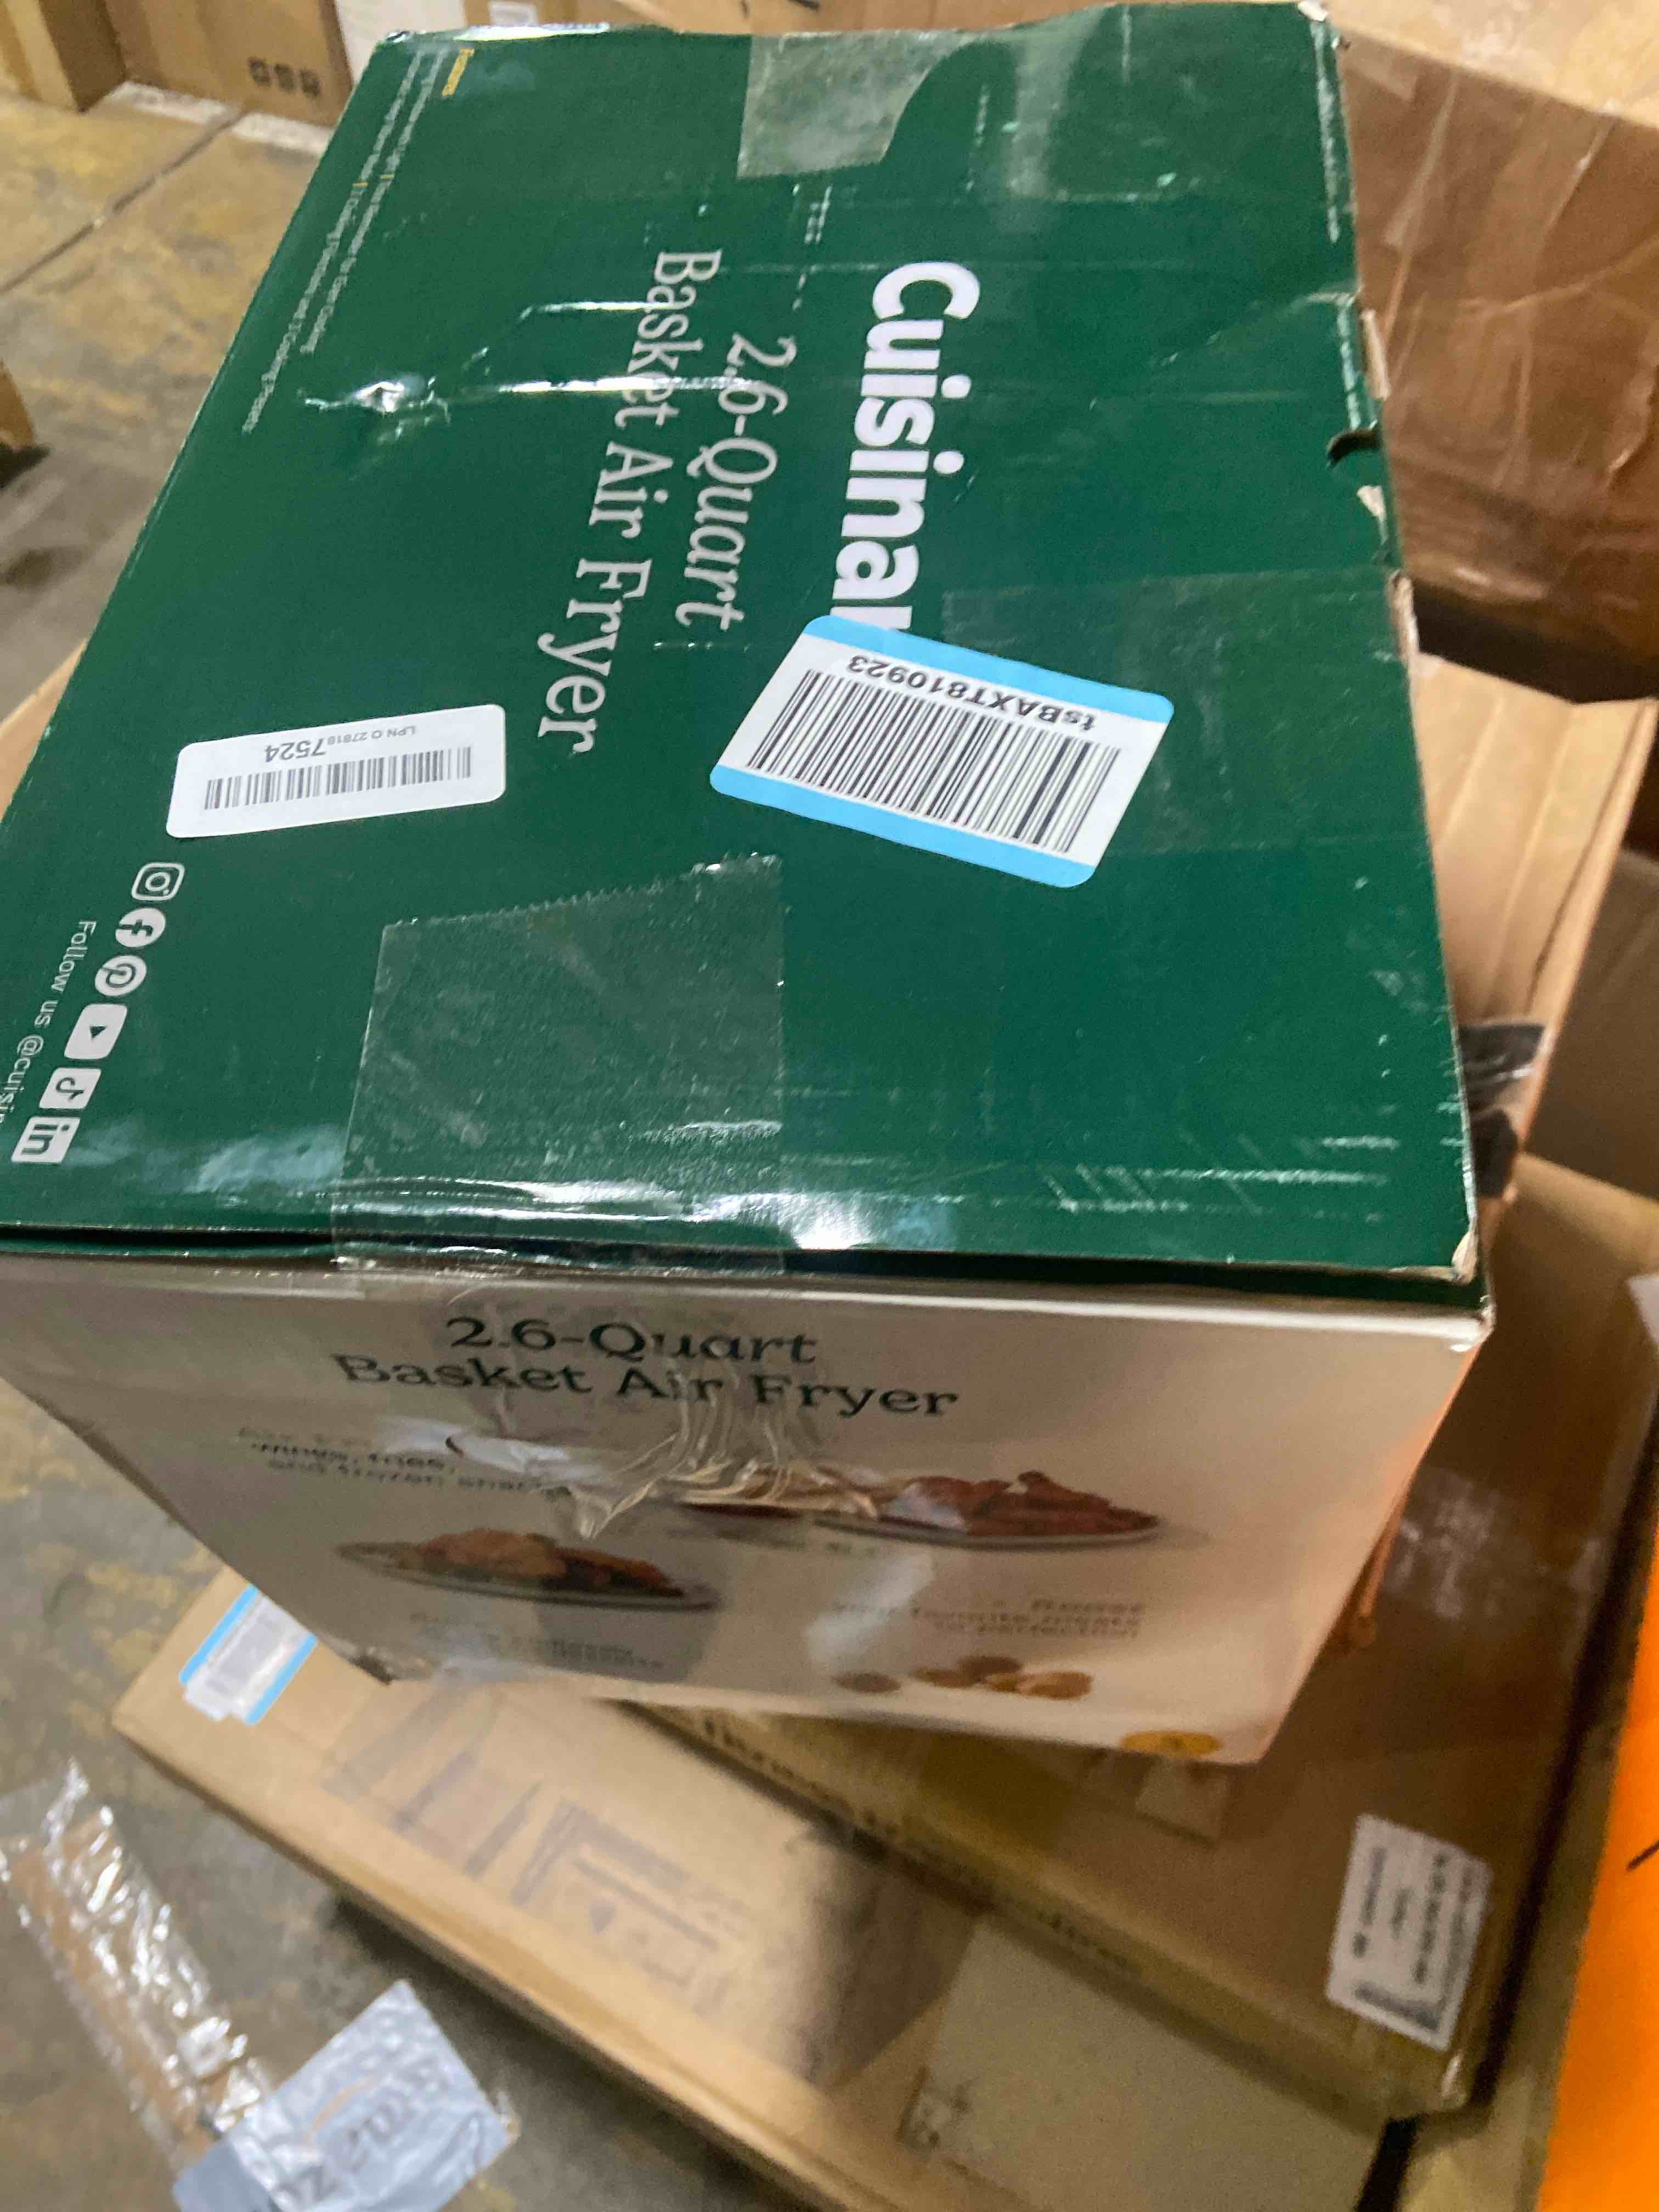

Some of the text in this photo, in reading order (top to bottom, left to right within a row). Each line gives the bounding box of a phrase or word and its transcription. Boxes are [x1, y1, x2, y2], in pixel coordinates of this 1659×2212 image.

[537, 249, 723, 753] Basket Air Fryer
[675, 332, 797, 630] 2.6-Quart
[848, 654, 1097, 732] tsBAXT810923
[387, 725, 416, 738] LPN
[51, 919, 97, 994] Follow
[35, 1000, 58, 1028] us
[447, 1316, 819, 1365] 2.6-Quart
[329, 1352, 960, 1418] Basket Air Fryer
